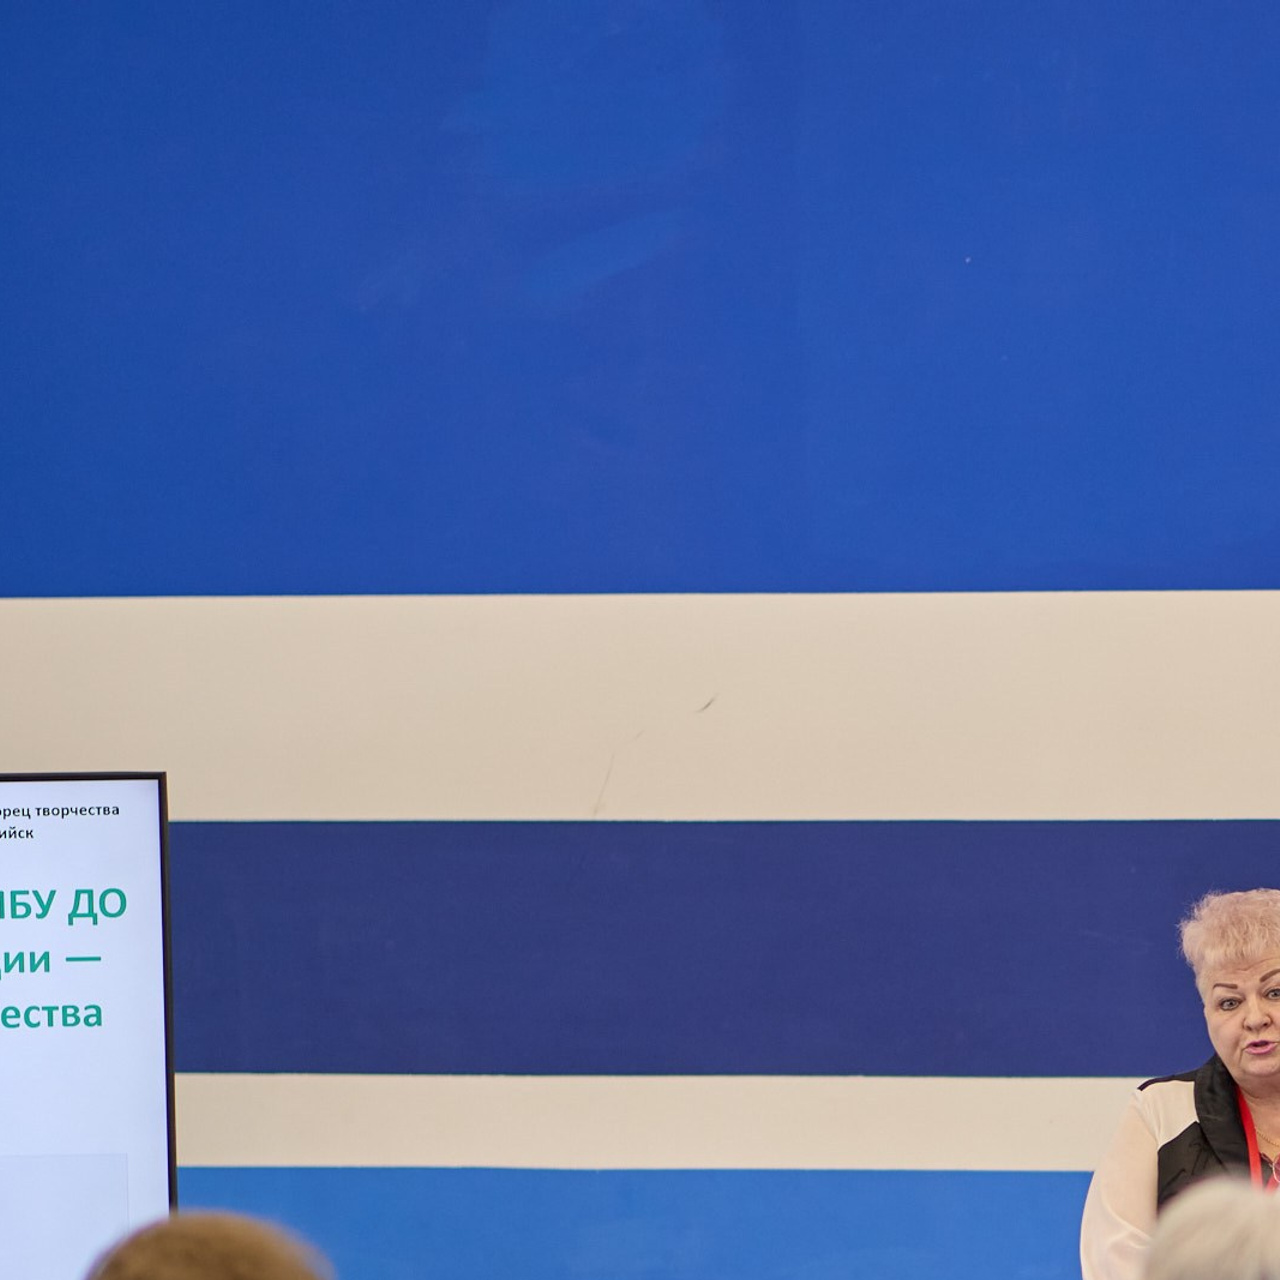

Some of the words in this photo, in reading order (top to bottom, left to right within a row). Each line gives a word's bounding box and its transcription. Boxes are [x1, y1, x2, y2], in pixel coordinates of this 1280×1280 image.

[0, 807, 31, 819] рец
[35, 806, 120, 819] творчества
[0, 889, 57, 919] БУ
[68, 888, 127, 926] ДО
[0, 951, 50, 981] ии
